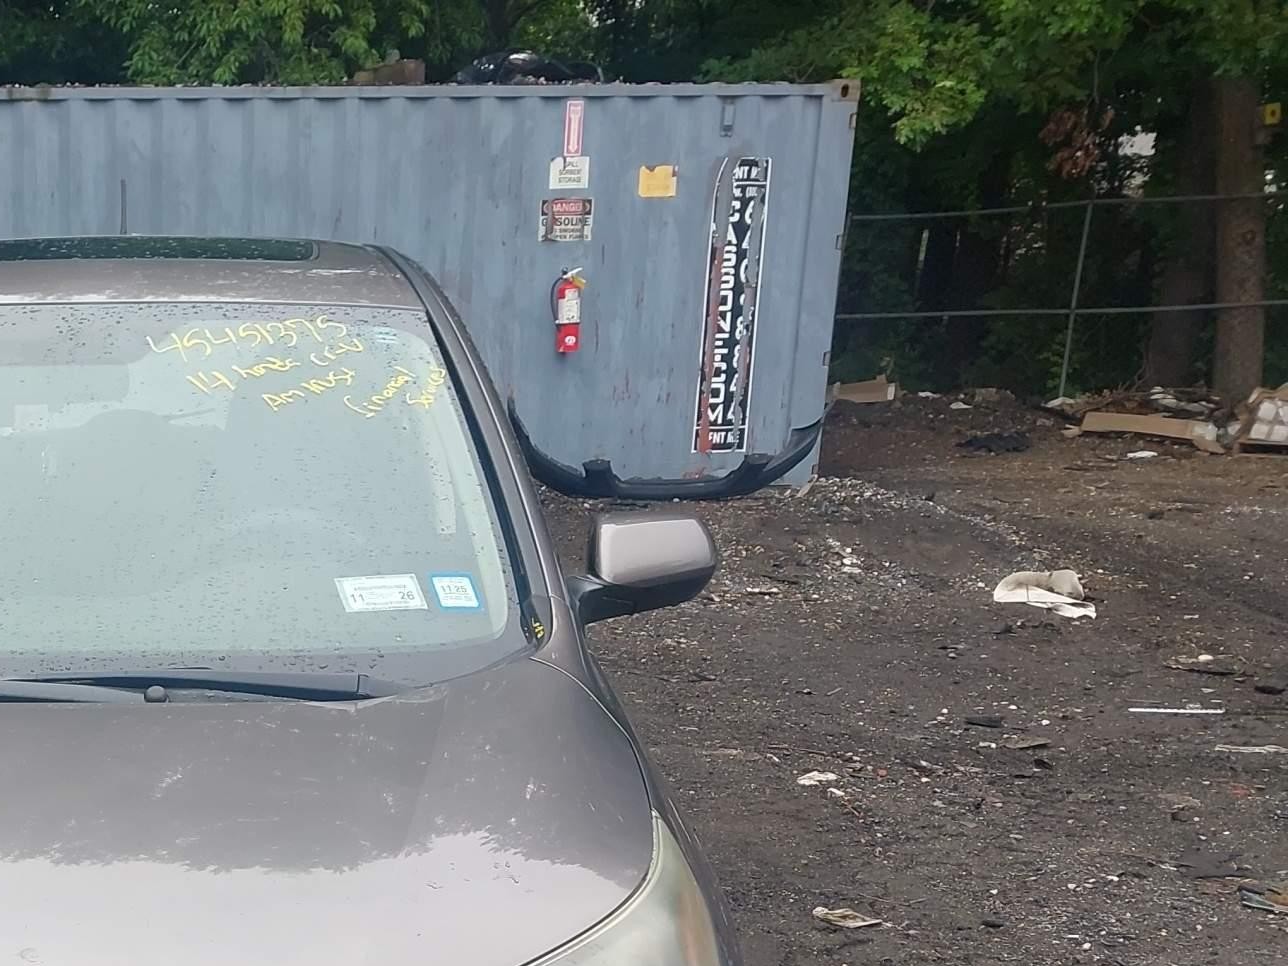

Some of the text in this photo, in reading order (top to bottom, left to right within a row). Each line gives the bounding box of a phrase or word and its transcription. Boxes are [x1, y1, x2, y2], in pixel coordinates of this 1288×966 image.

[542, 217, 591, 227] GSOLINE
[146, 315, 347, 362] 45451375
[350, 590, 416, 603] 11 26
